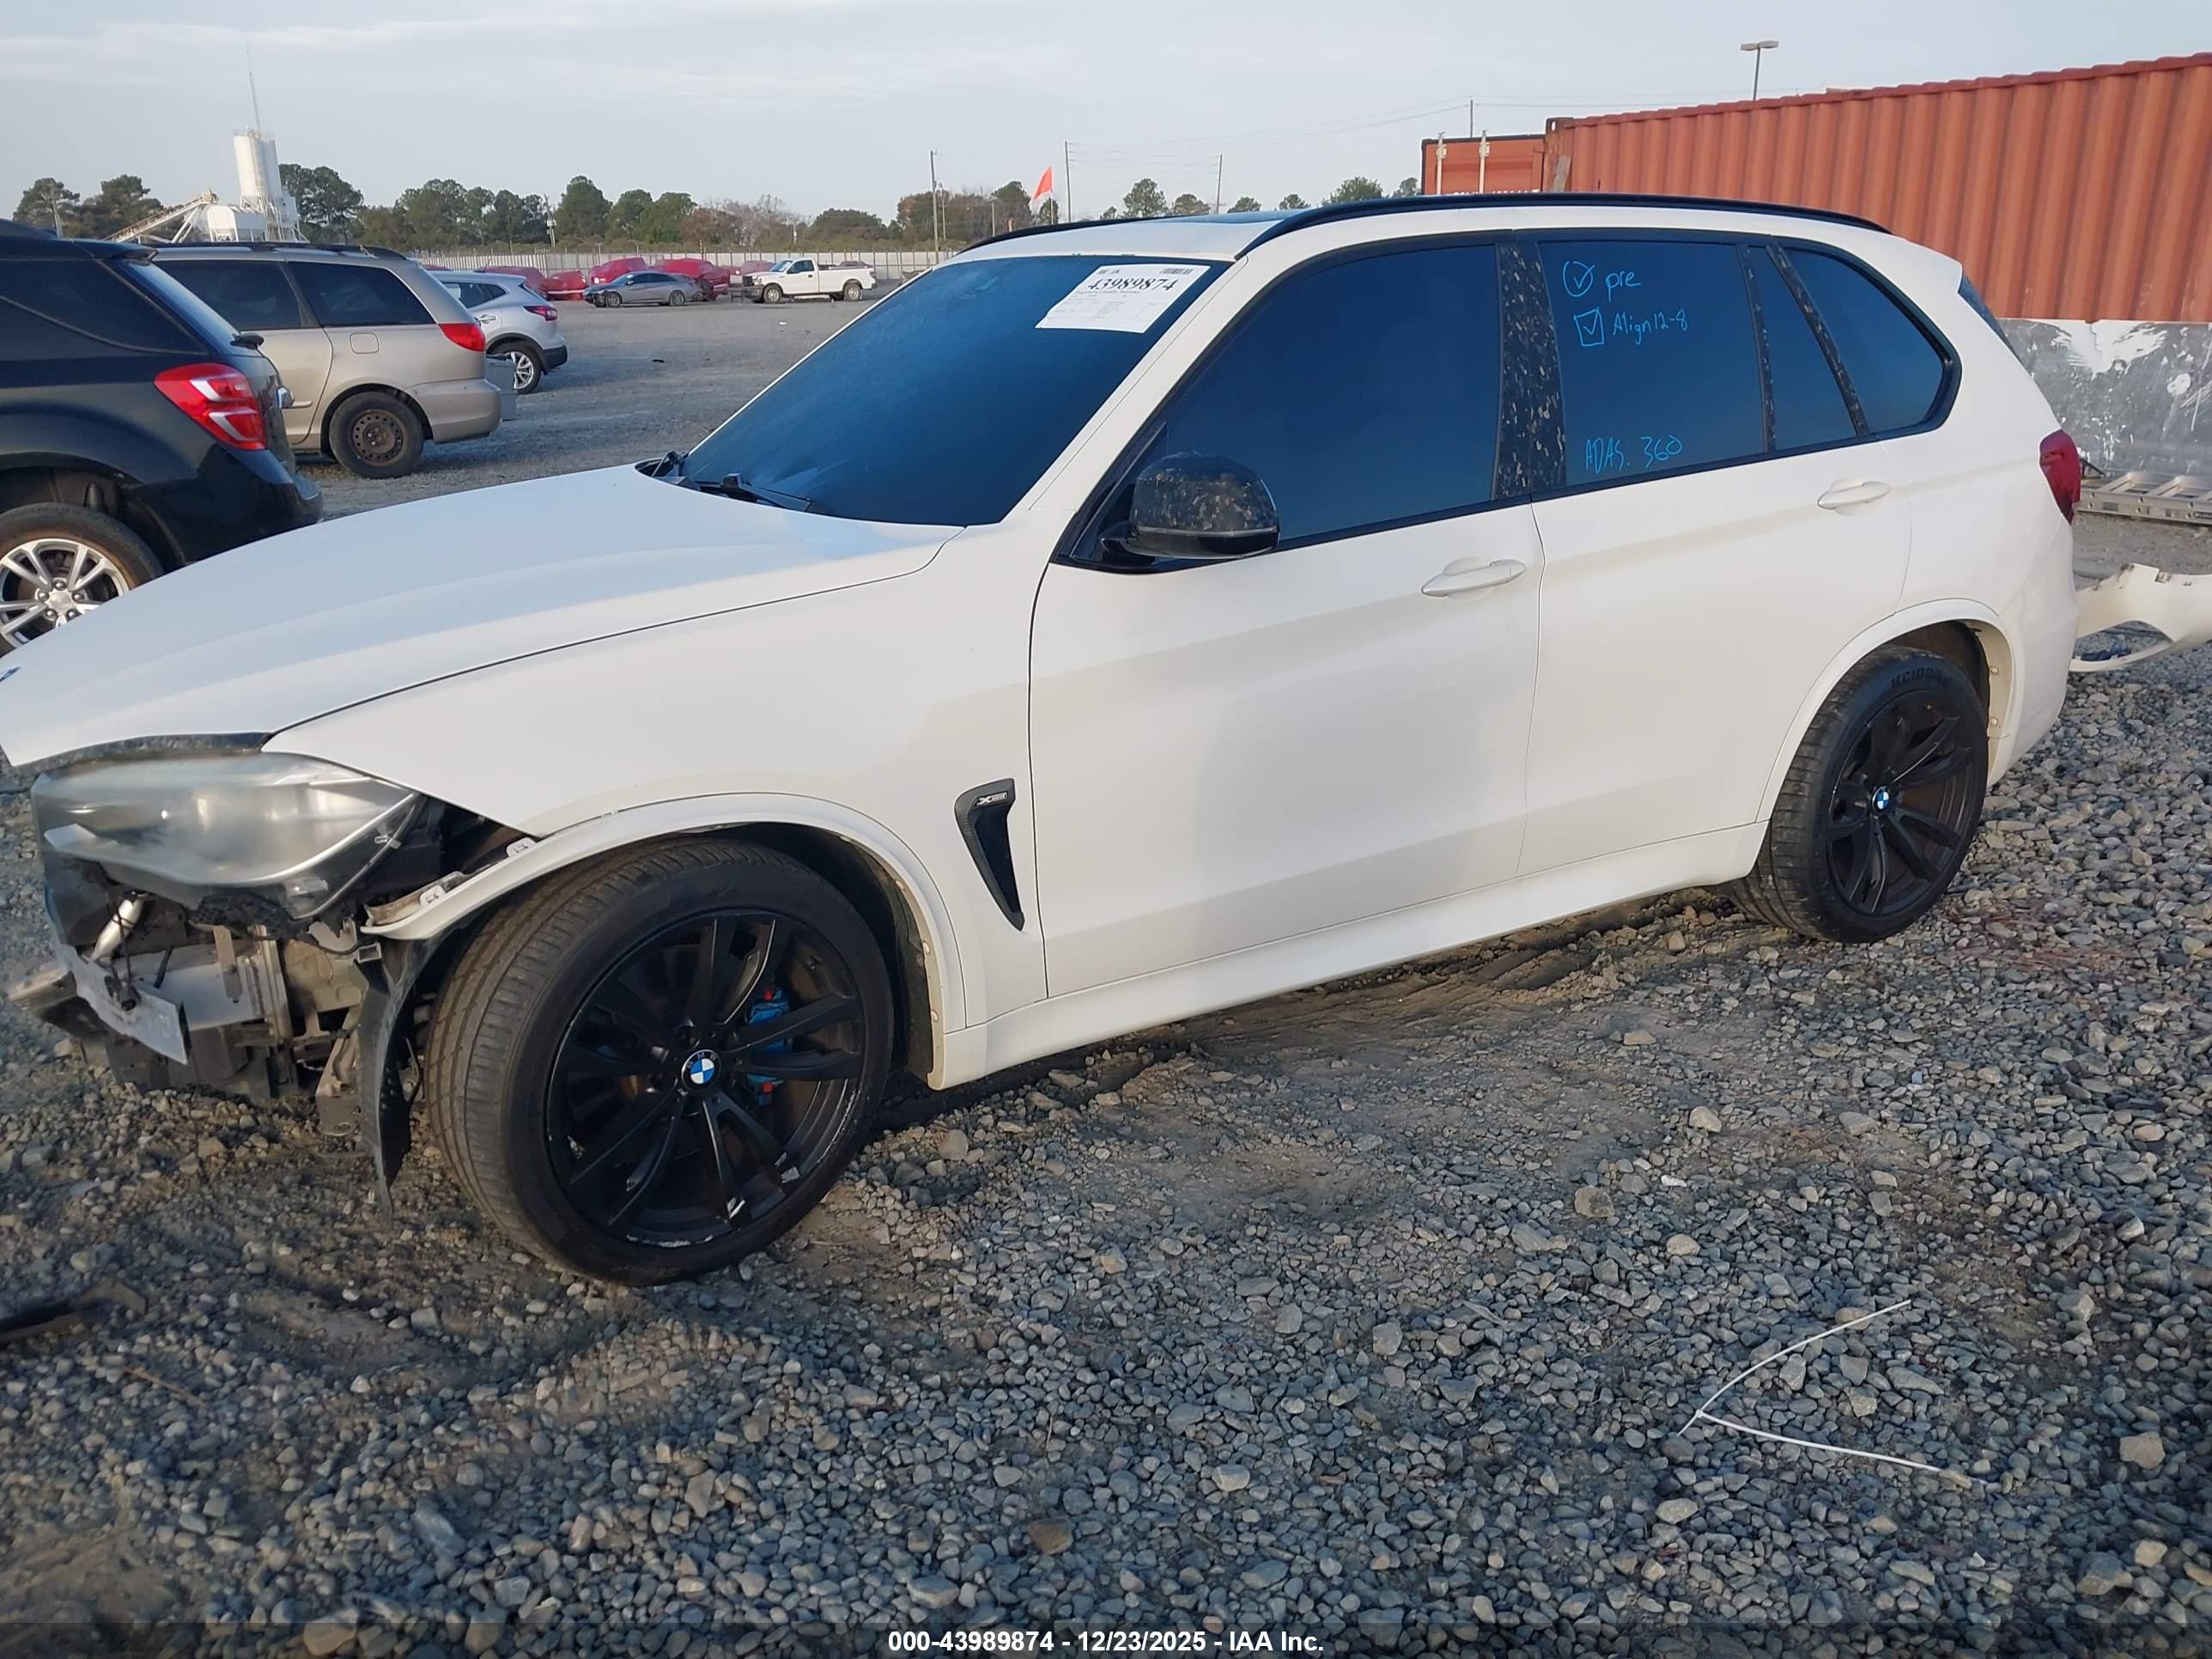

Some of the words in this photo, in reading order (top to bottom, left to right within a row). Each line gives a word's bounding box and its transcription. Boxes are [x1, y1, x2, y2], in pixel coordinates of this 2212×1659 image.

[1088, 277, 1179, 291] 43989874
[1605, 270, 1641, 302] pre
[1639, 434, 1683, 469] 360
